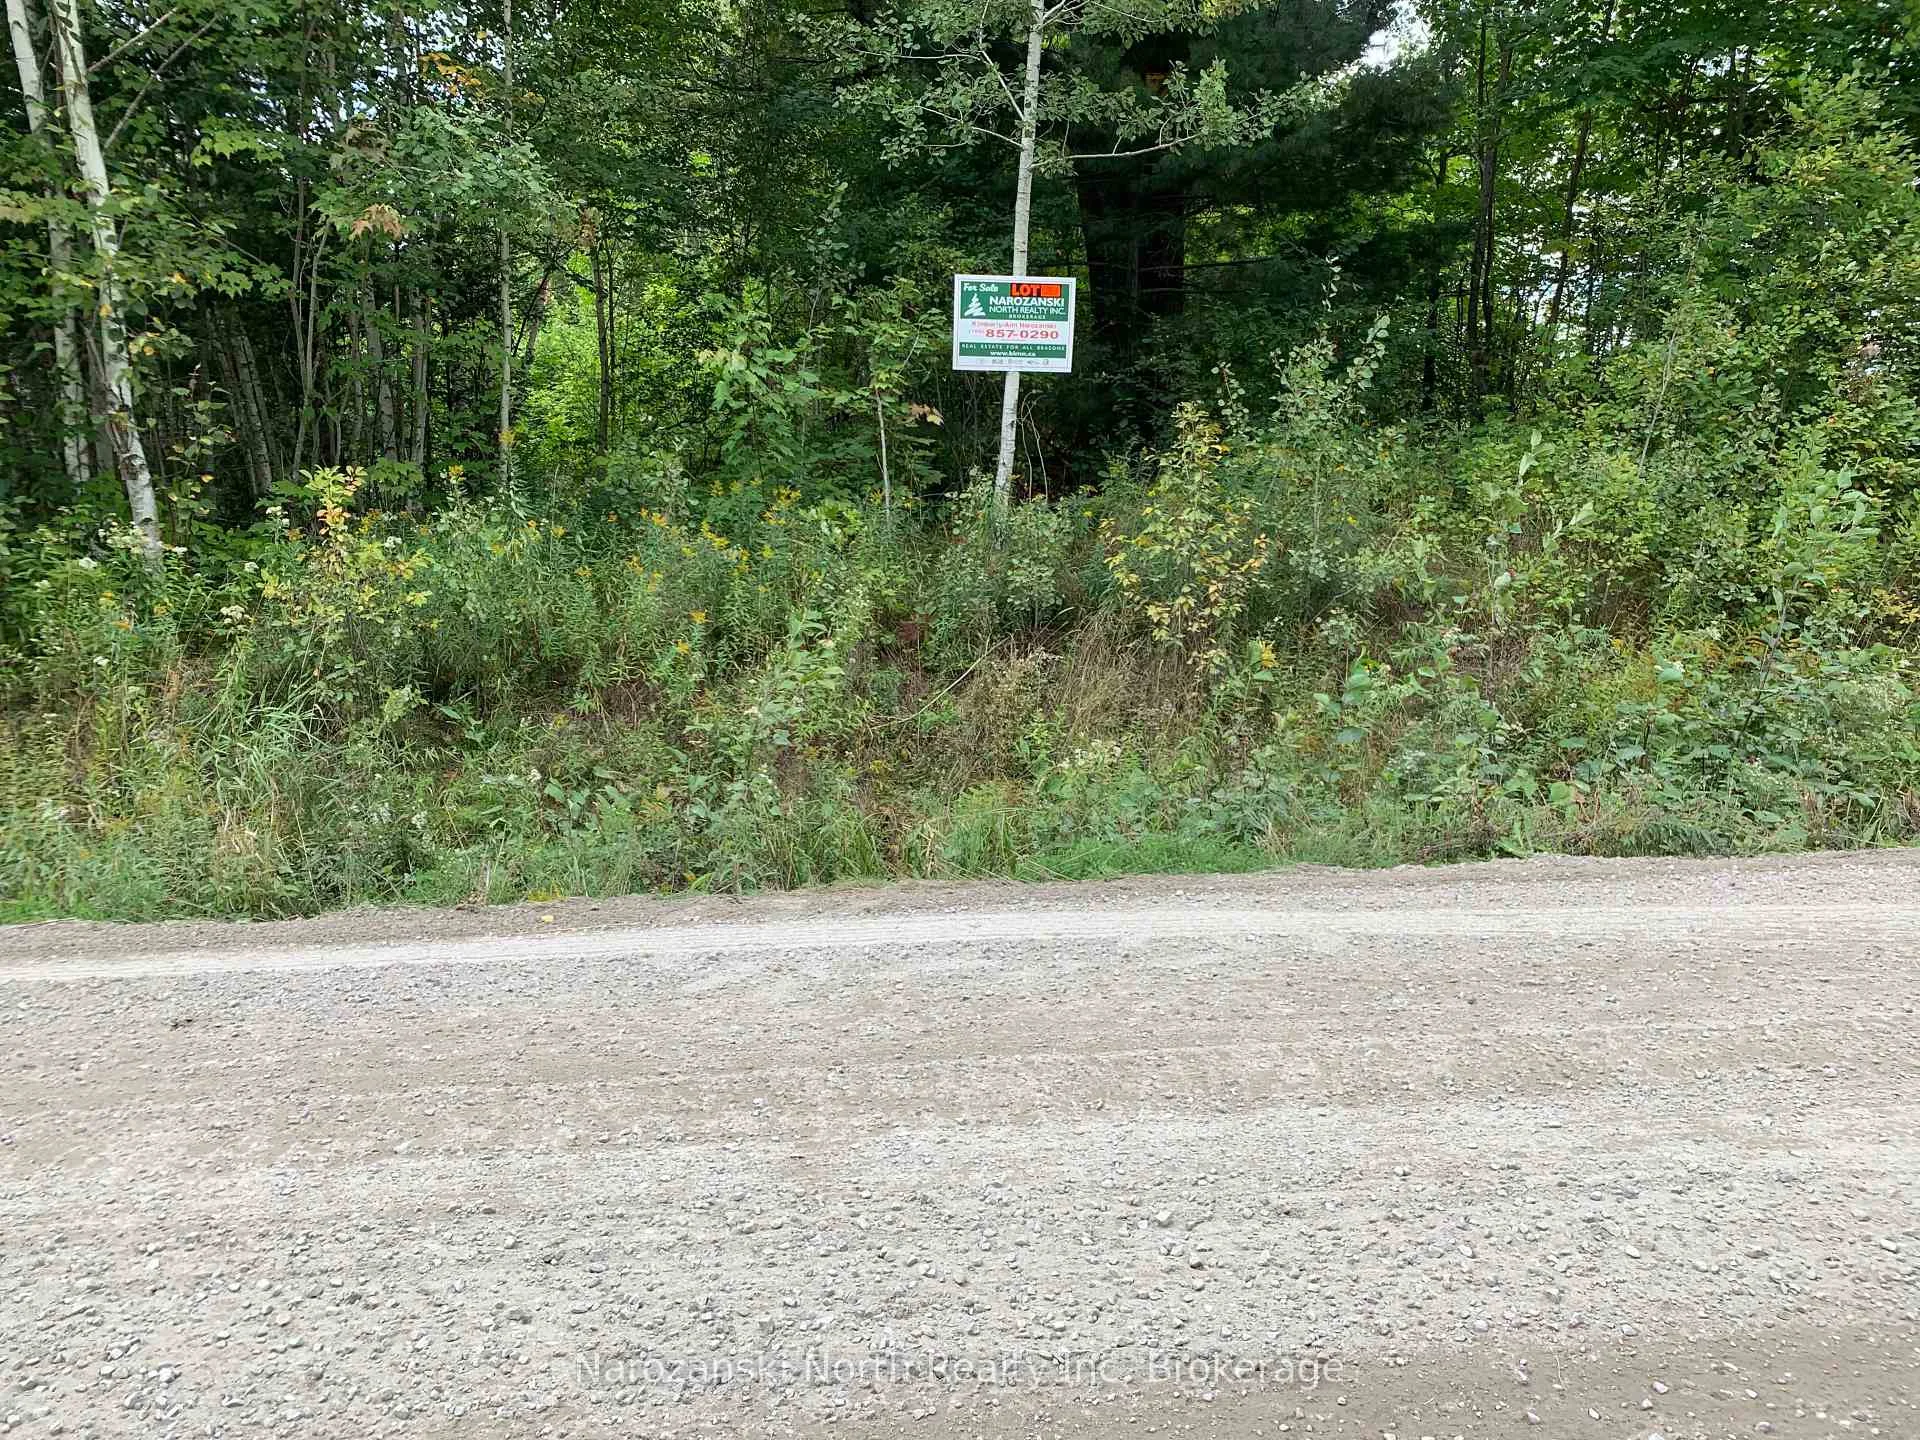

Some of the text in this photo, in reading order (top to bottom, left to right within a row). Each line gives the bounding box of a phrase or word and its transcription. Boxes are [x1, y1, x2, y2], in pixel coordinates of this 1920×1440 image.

[963, 283, 999, 293] For Sale
[1011, 283, 1041, 296] LOT
[989, 296, 1065, 307] NAROZANSKI
[989, 305, 1018, 314] NORTH
[1019, 306, 1048, 315] REALTY
[985, 329, 1059, 339] 857-0290
